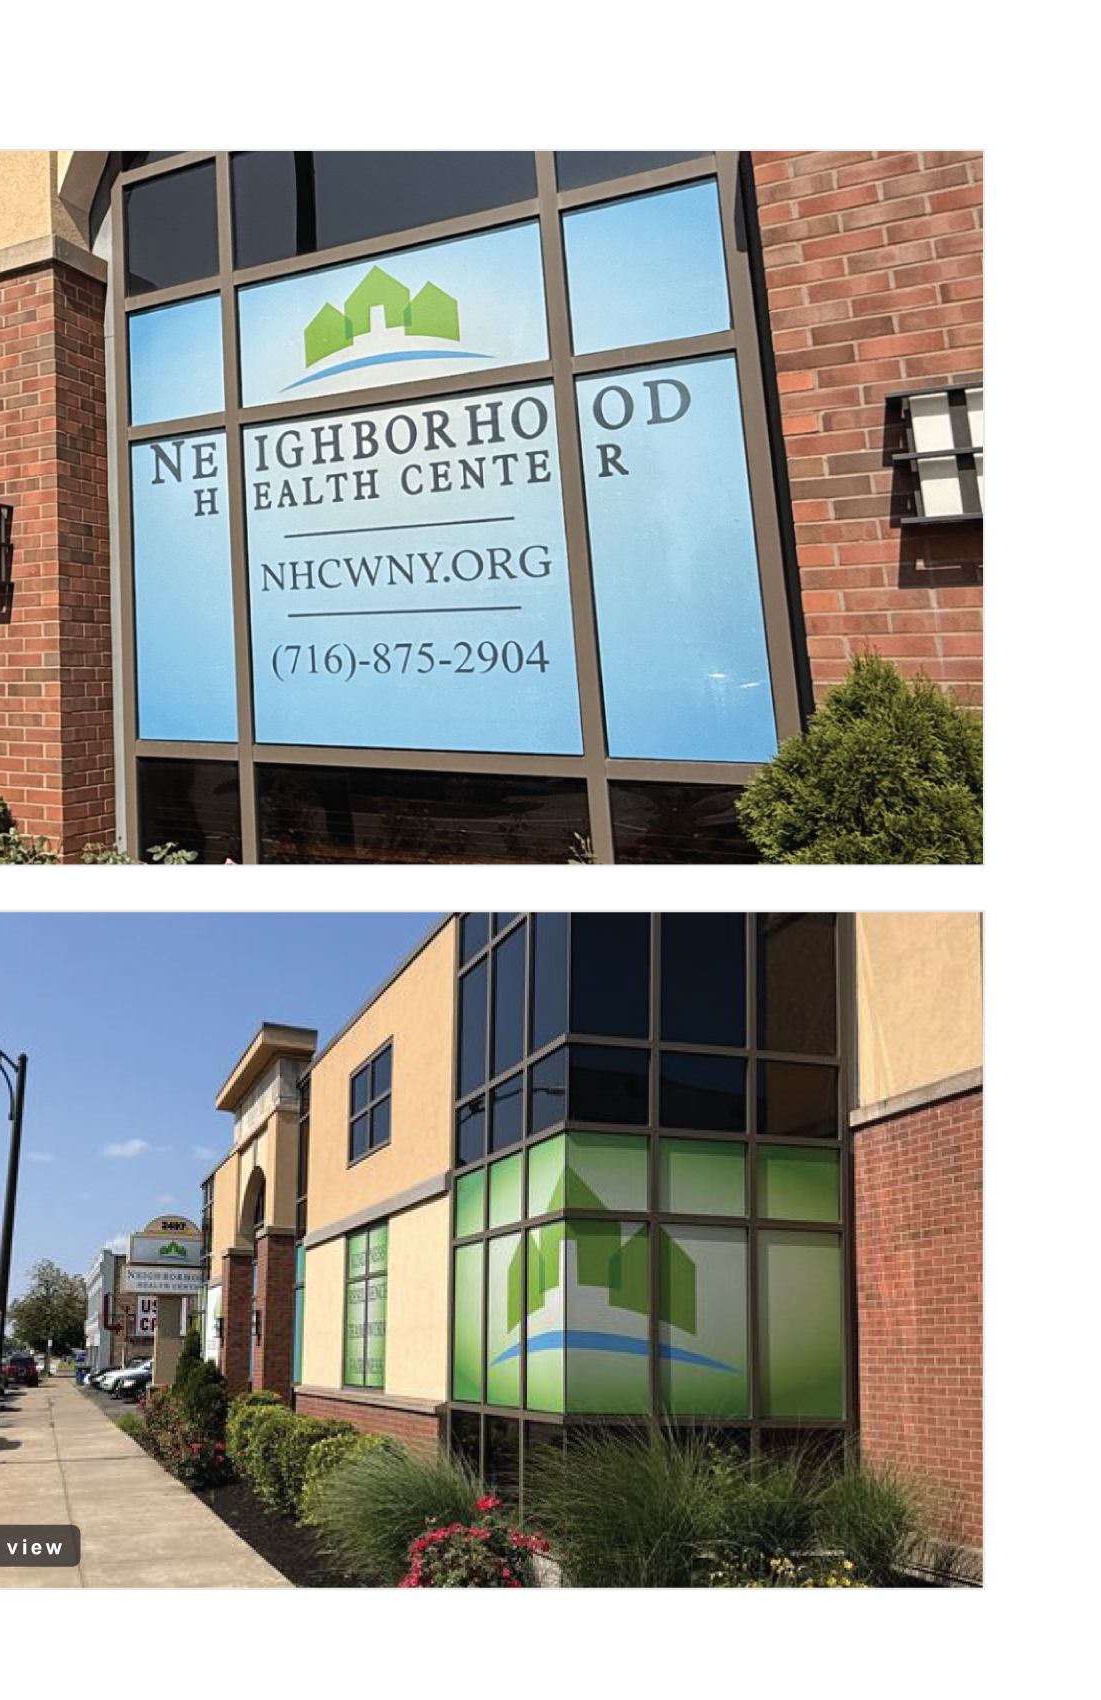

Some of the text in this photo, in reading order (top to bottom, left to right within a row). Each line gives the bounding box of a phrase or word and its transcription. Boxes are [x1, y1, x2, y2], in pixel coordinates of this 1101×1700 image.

[194, 442, 630, 517] HEALTH CENTER
[260, 544, 553, 592] NHCWNY.ORG
[271, 639, 550, 682] (716)-875-2904
